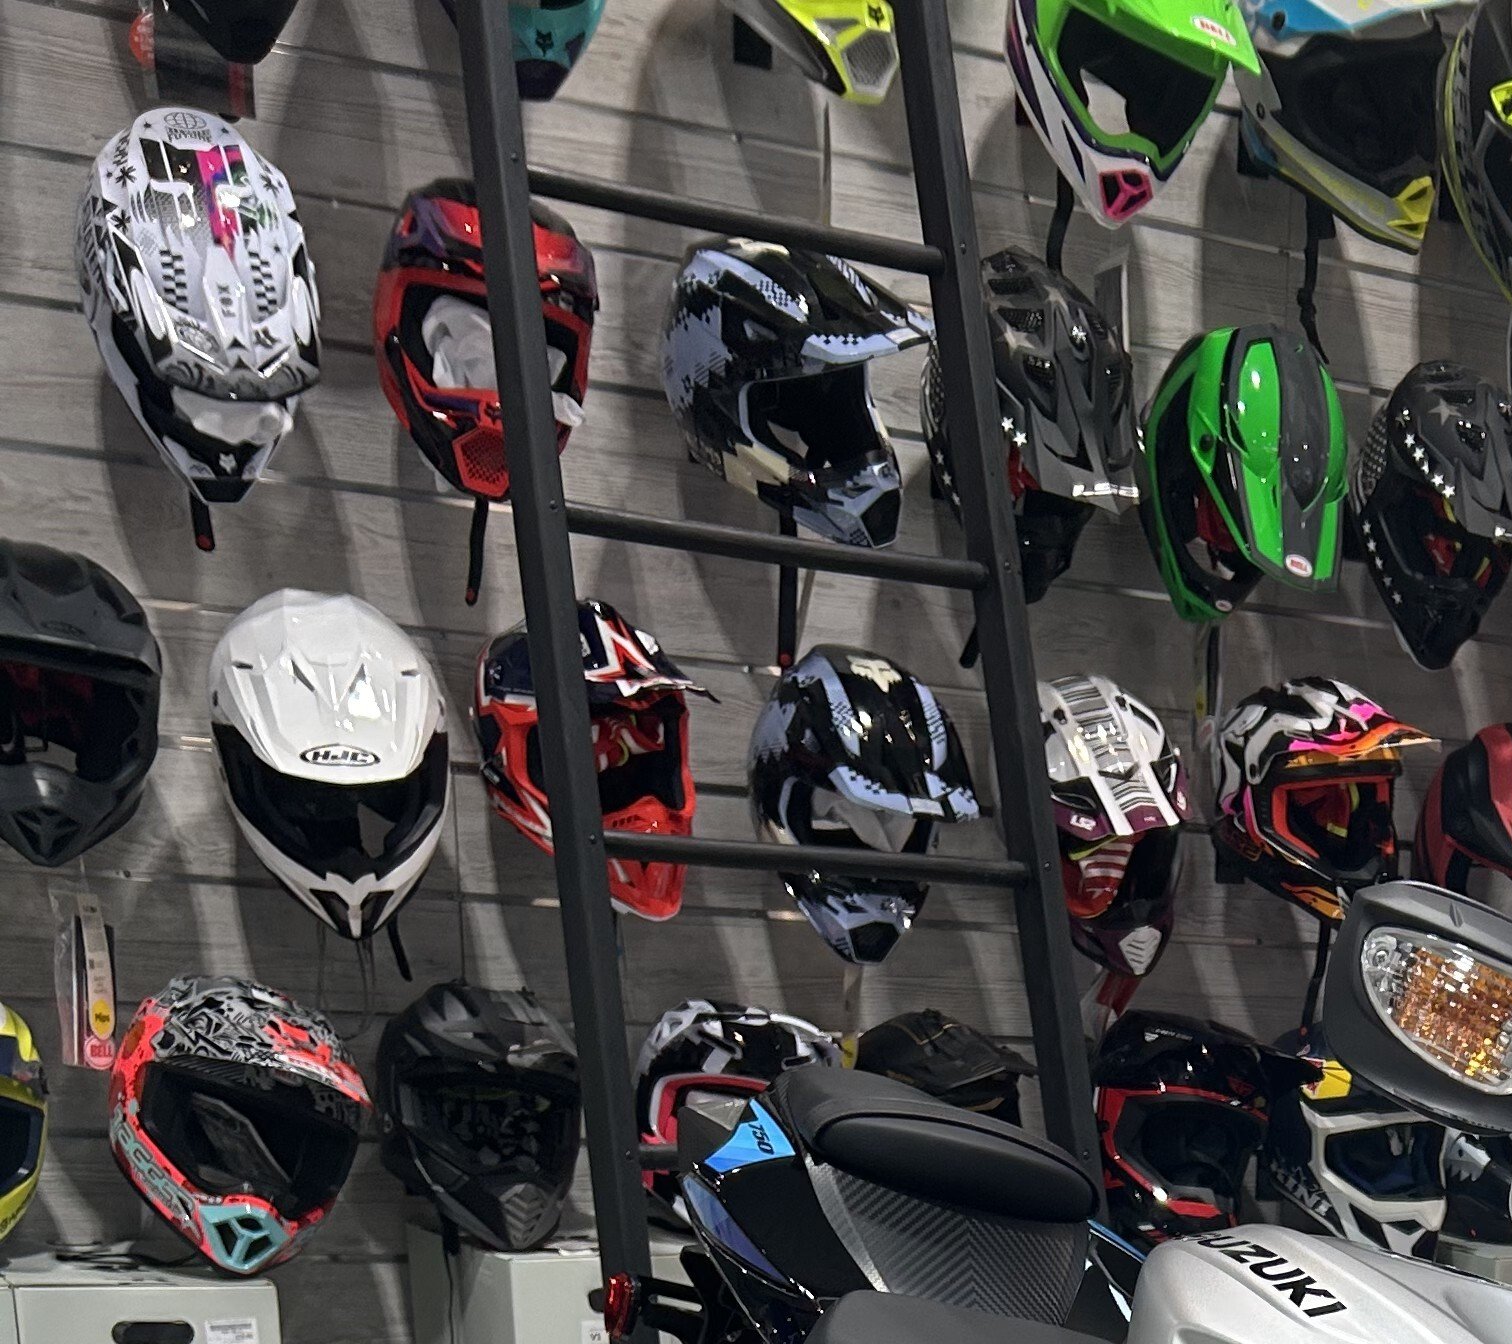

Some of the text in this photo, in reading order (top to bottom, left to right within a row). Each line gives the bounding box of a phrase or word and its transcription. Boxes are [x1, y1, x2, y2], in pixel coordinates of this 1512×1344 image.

[218, 281, 237, 319] FOX
[310, 747, 371, 765] HJC
[89, 1044, 113, 1059] BELL
[749, 1121, 776, 1157] 750
